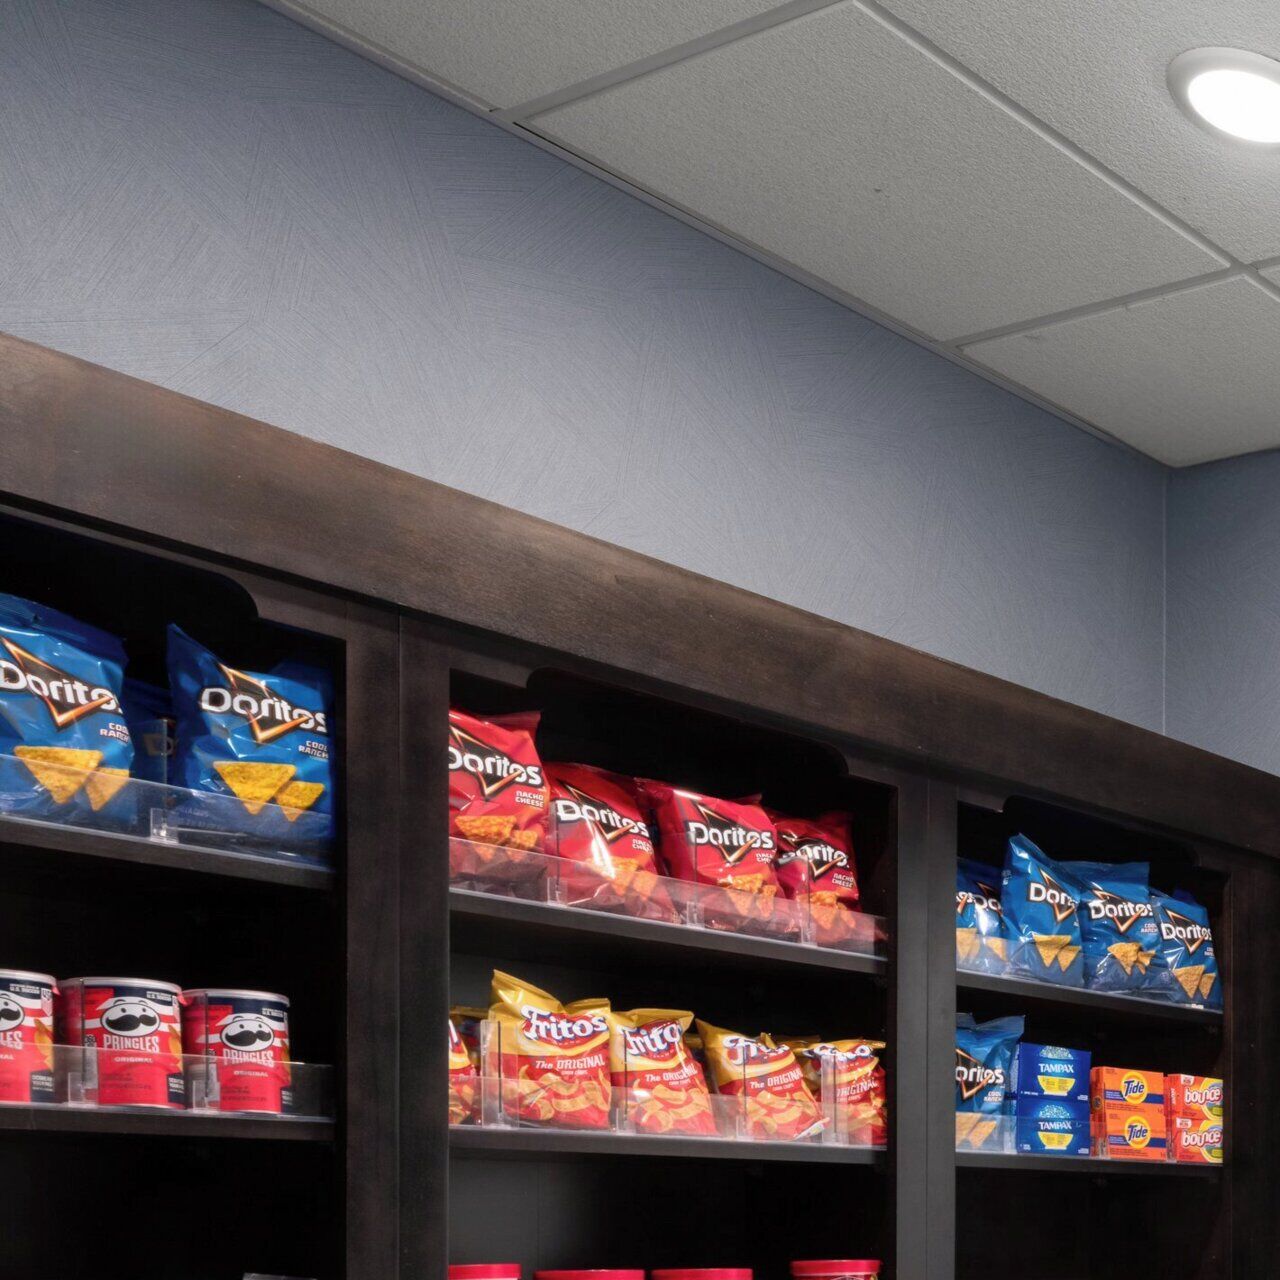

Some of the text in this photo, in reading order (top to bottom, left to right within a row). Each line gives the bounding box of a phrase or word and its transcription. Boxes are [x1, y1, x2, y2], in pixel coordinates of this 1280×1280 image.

[0, 660, 123, 714] Dorito
[201, 687, 328, 732] Doritos
[515, 797, 544, 808] CHEESE
[516, 790, 544, 801] NACHO
[557, 799, 649, 836] Doritos
[688, 822, 773, 849] Doritos
[521, 1005, 608, 1041] Fritos
[103, 1034, 160, 1053] PRINGLES
[616, 1023, 682, 1056] Frito
[223, 1048, 275, 1069] PRINGLES
[535, 1053, 605, 1069] The ORIGINAL
[955, 1066, 1004, 1084] oritos
[1038, 1063, 1074, 1073] TAMPAX
[751, 1068, 803, 1089] The ORIGINA
[1124, 1080, 1145, 1097] Tide
[1184, 1087, 1221, 1104] bounce
[1038, 1121, 1072, 1130] TAMPAX
[1127, 1124, 1148, 1141] Tide
[1182, 1130, 1222, 1148] bounce
